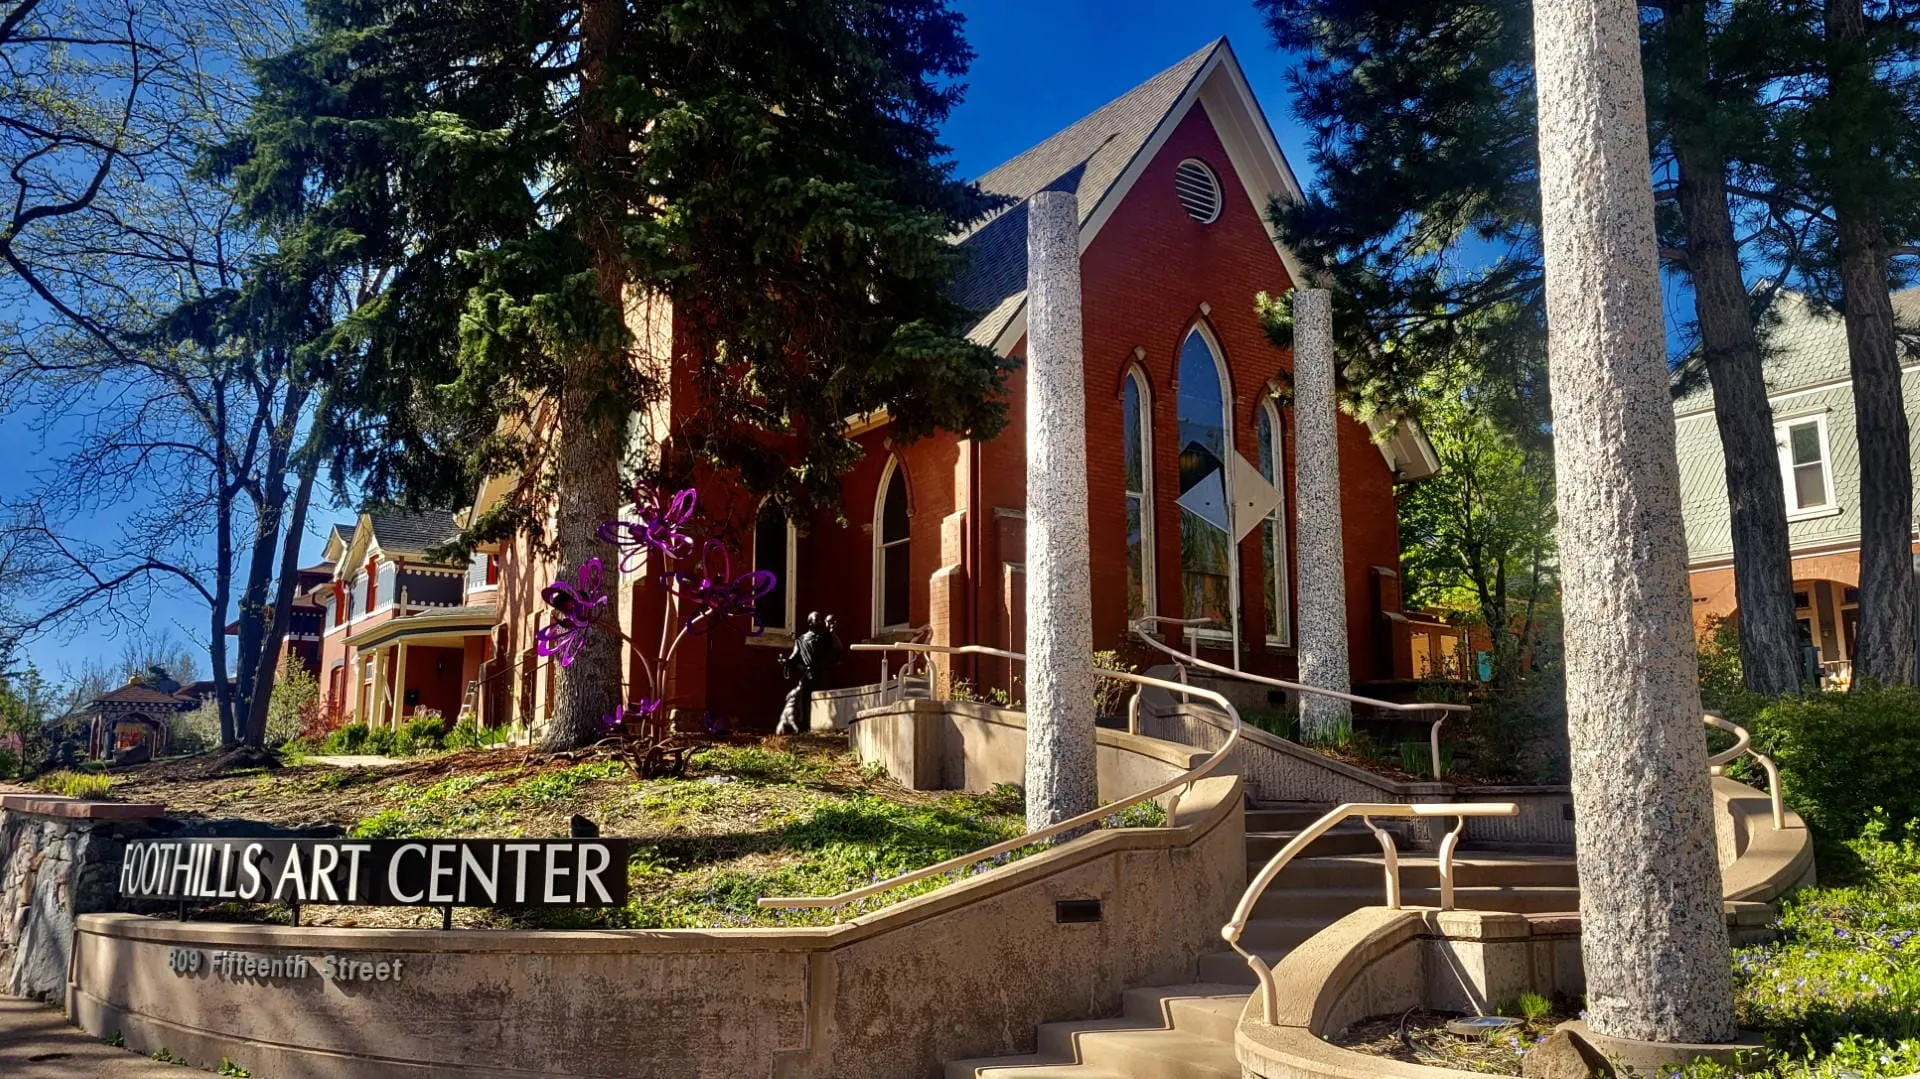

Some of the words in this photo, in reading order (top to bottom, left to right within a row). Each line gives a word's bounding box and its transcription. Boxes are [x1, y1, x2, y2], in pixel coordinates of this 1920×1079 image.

[119, 842, 263, 900] FOOTHILLS
[273, 842, 372, 901] ART
[388, 843, 614, 904] CENTER
[167, 948, 199, 972] 809
[209, 950, 309, 979] Fifteenth
[322, 954, 403, 982] Street
